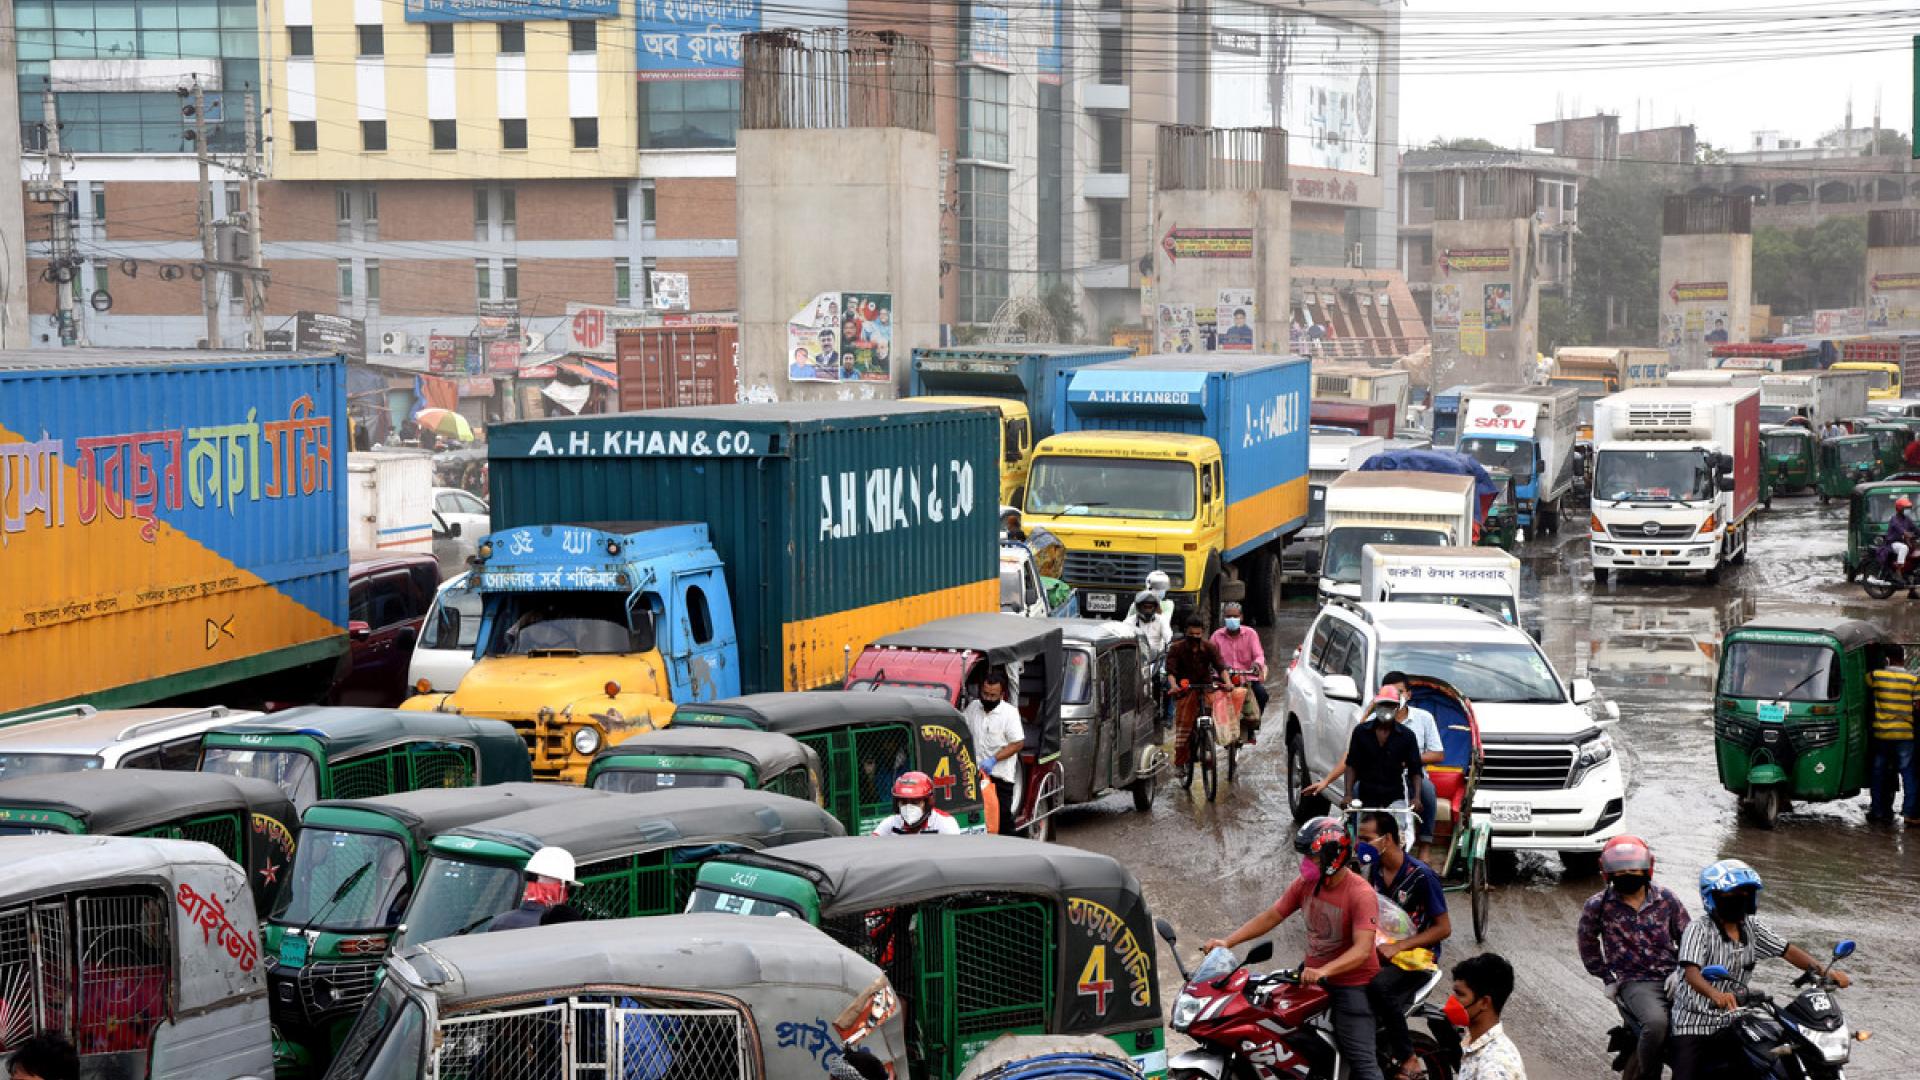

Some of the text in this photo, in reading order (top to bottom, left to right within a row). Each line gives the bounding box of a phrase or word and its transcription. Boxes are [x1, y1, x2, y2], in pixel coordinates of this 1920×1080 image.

[641, 32, 681, 60] অব
[932, 755, 957, 801] 4
[1077, 944, 1115, 1017] 4
